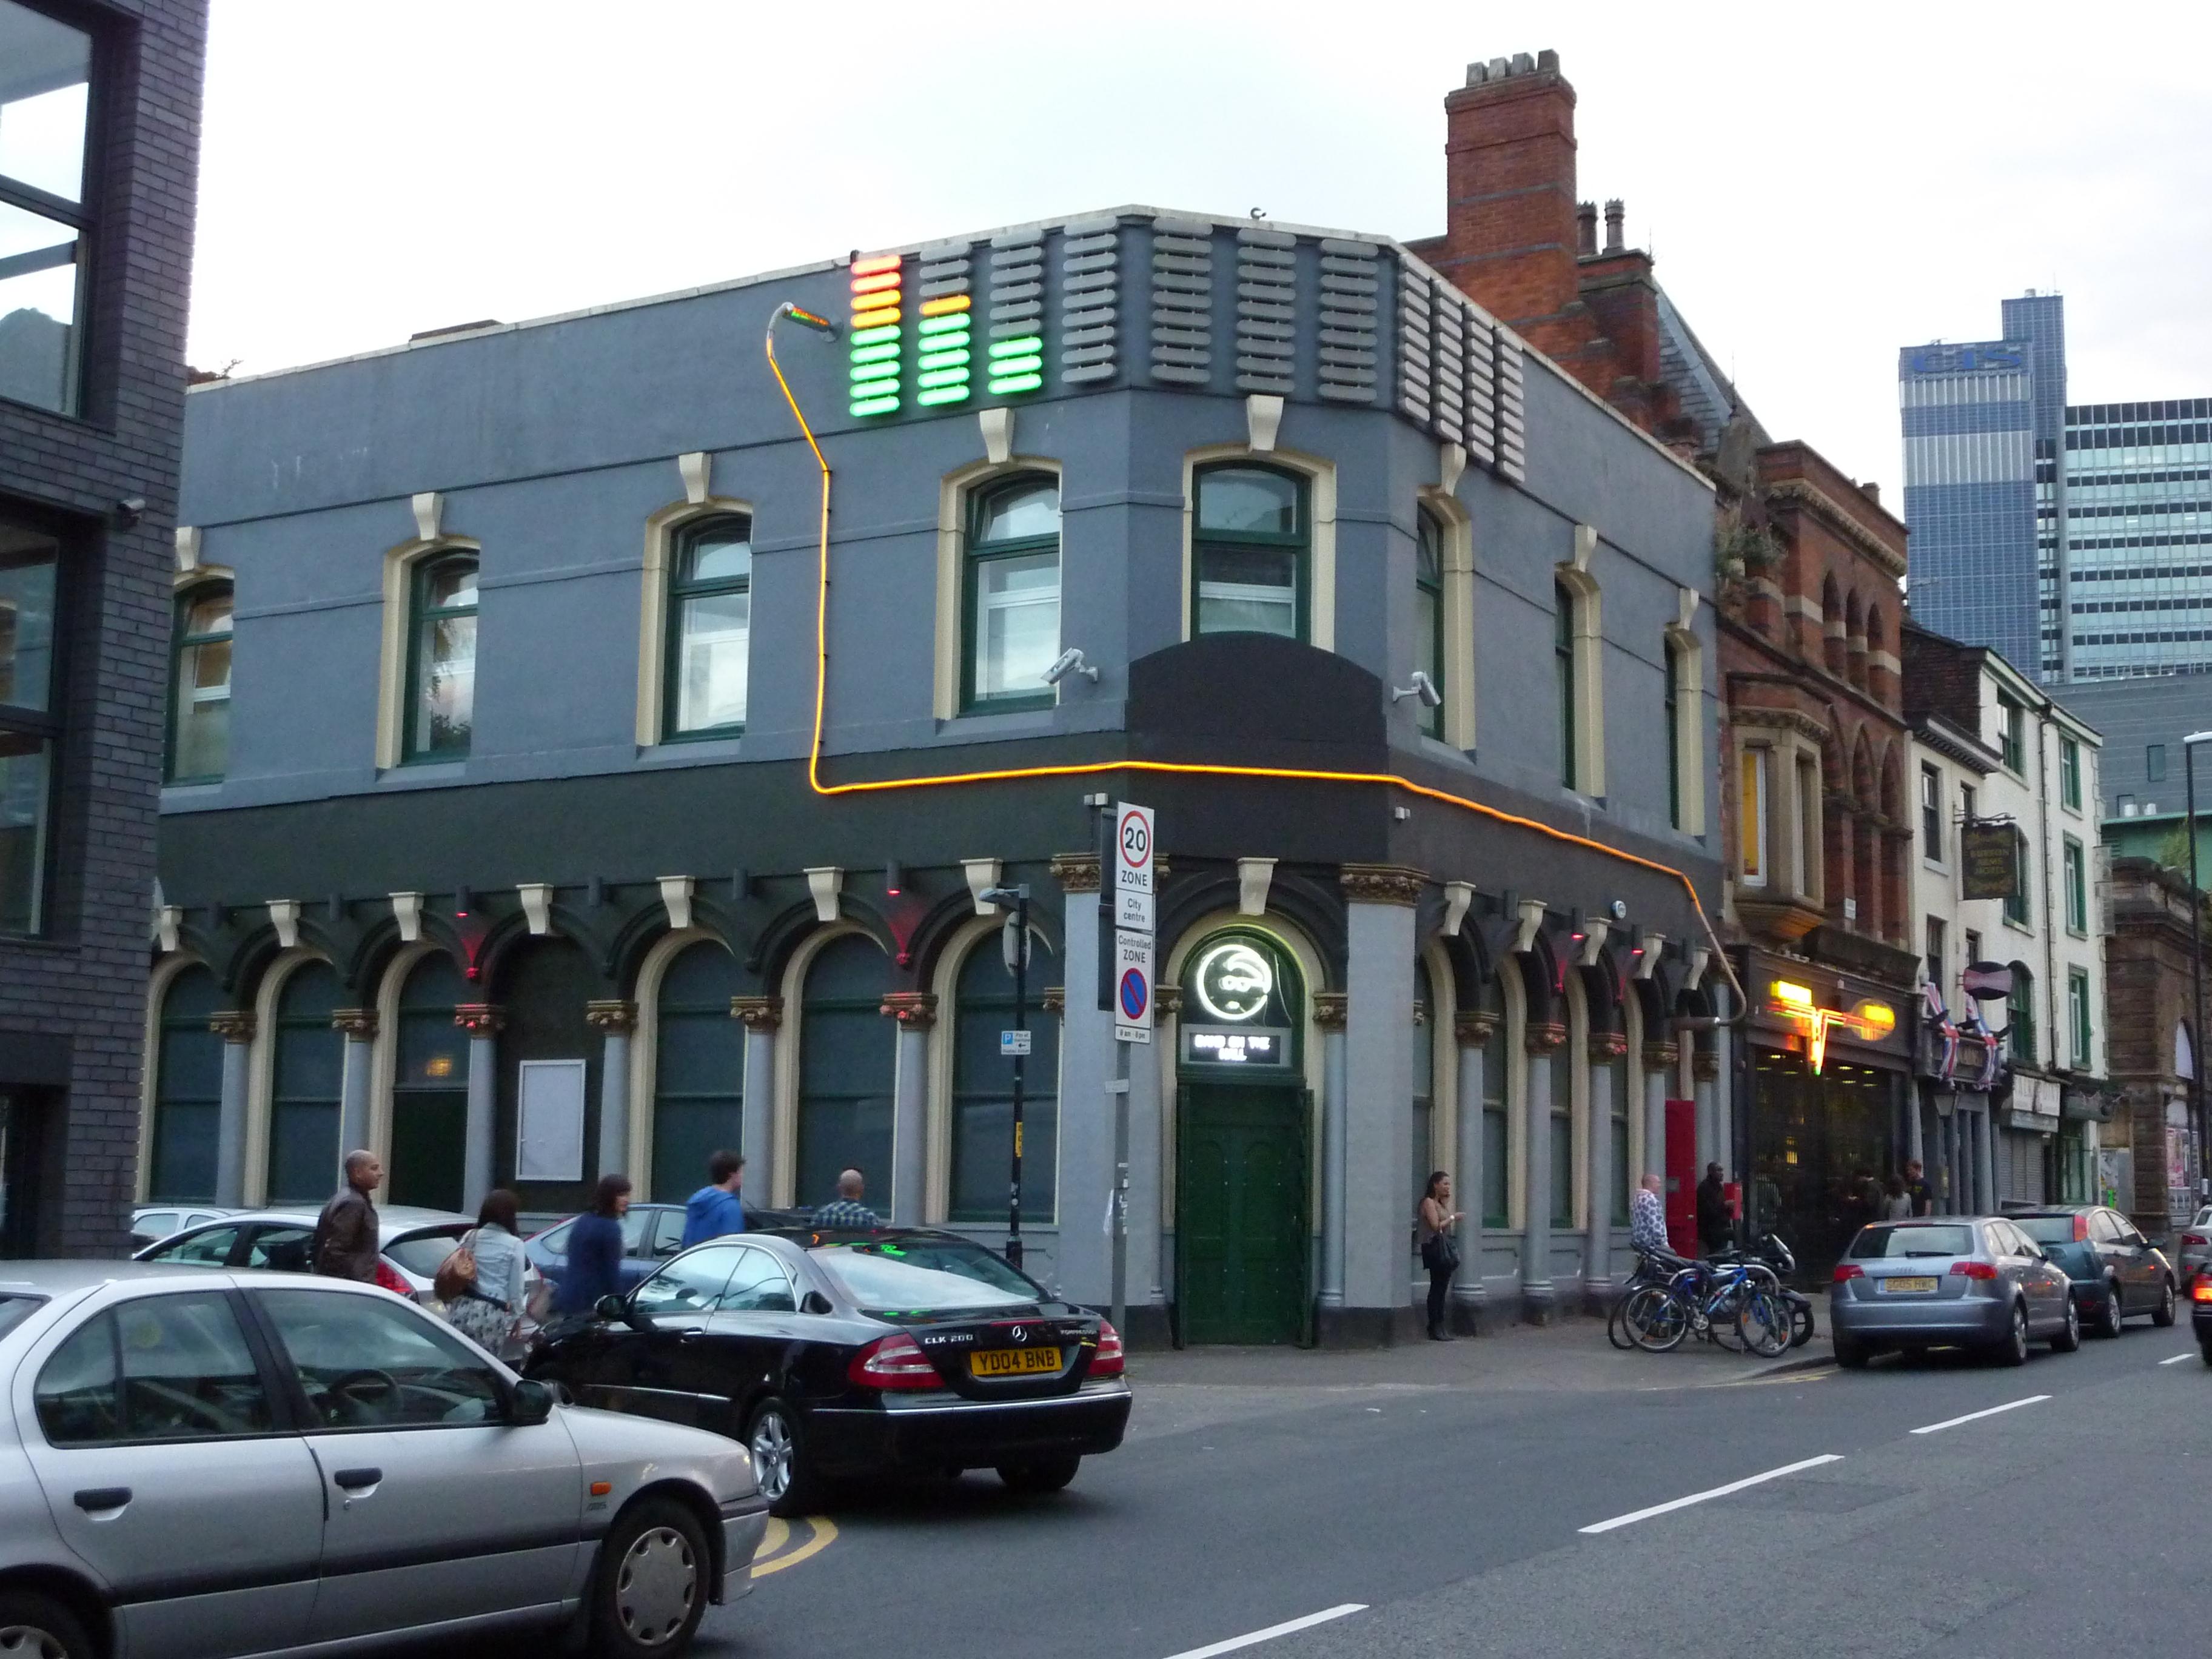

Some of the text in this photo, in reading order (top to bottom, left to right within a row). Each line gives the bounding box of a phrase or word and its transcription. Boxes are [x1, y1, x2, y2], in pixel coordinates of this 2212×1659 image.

[1913, 347, 2021, 372] CIS
[1125, 827, 1146, 852] 20
[1122, 870, 1147, 886] ZONE
[1128, 898, 1142, 911] City
[1124, 912, 1145, 922] centre
[1119, 934, 1151, 950] Controlled
[1124, 949, 1146, 963] ZONE
[1005, 1033, 1012, 1044] P
[951, 1334, 973, 1342] 200
[979, 1350, 1055, 1370] YD04 BNB
